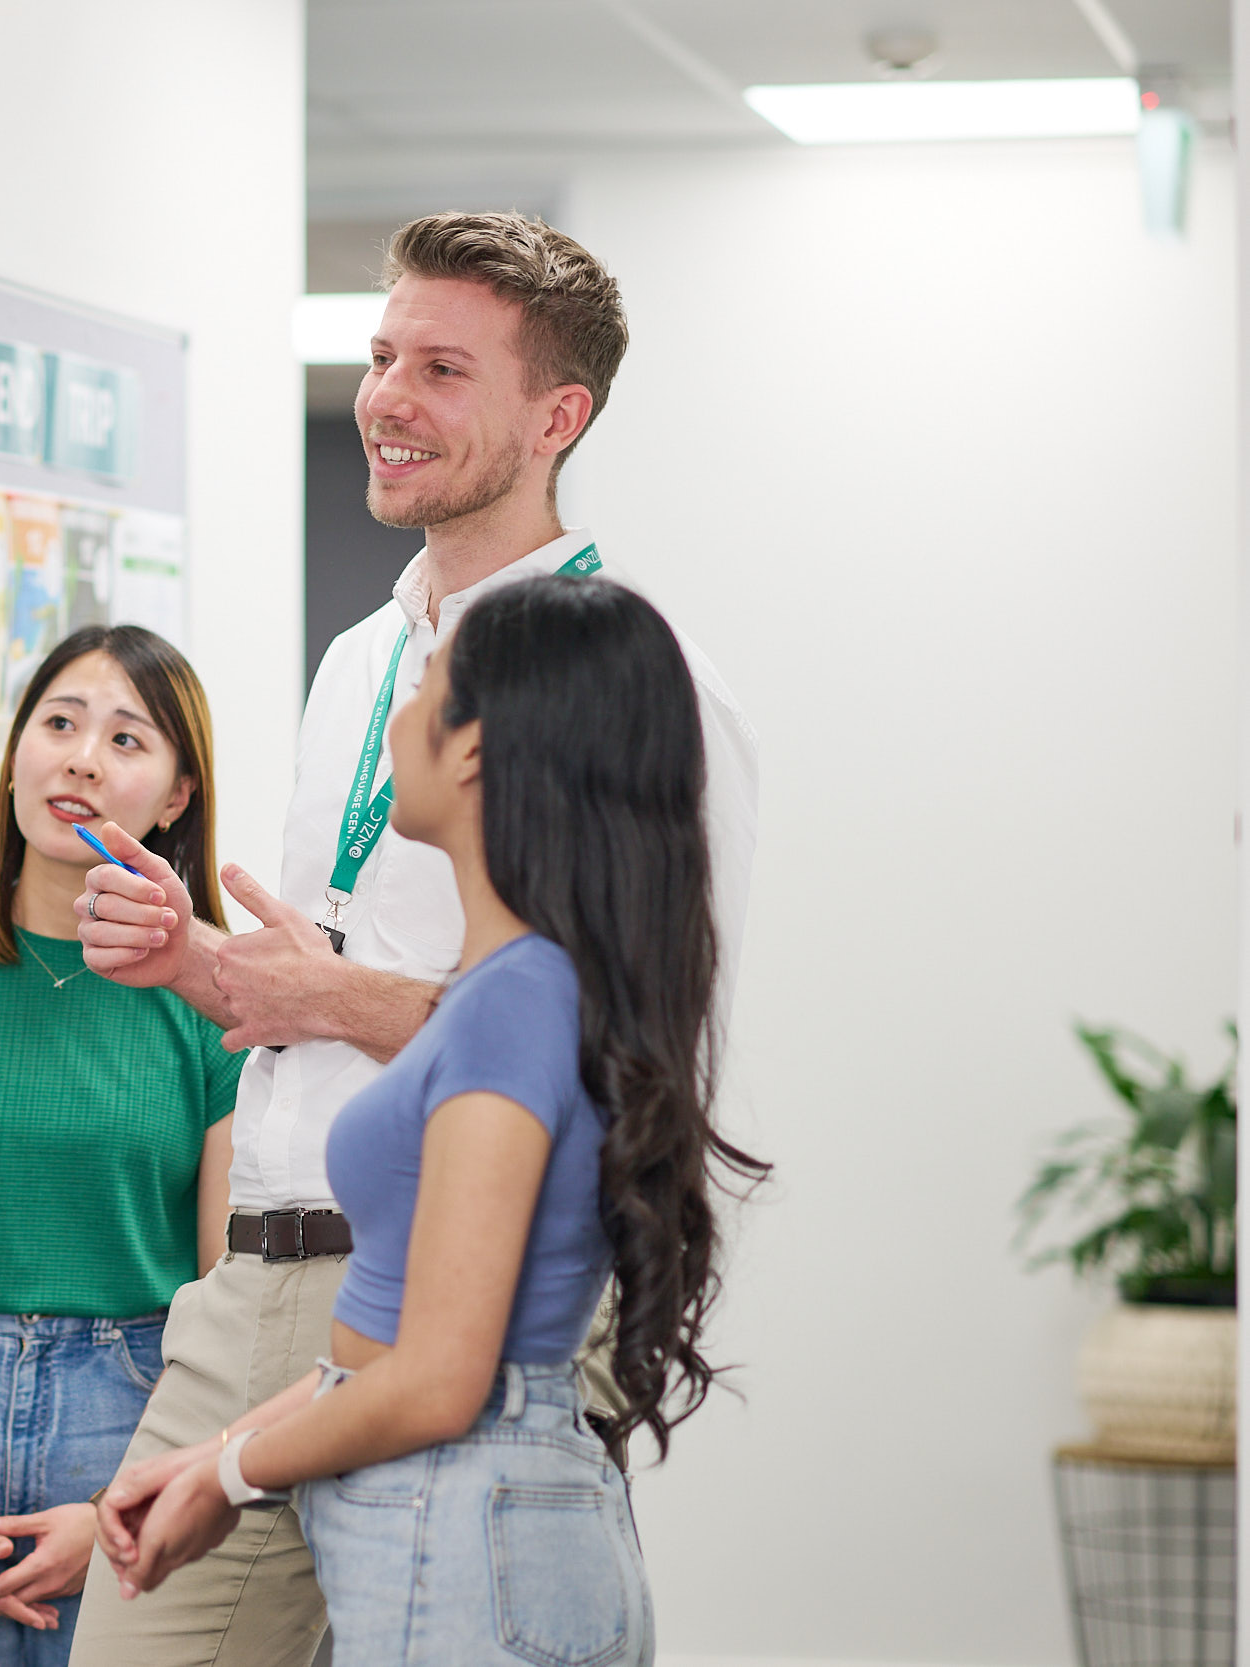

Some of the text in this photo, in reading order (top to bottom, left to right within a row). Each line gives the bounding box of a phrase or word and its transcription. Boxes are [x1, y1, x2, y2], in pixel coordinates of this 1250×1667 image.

[346, 679, 391, 844] NEW ZEALAND LANGUAGE CEN
